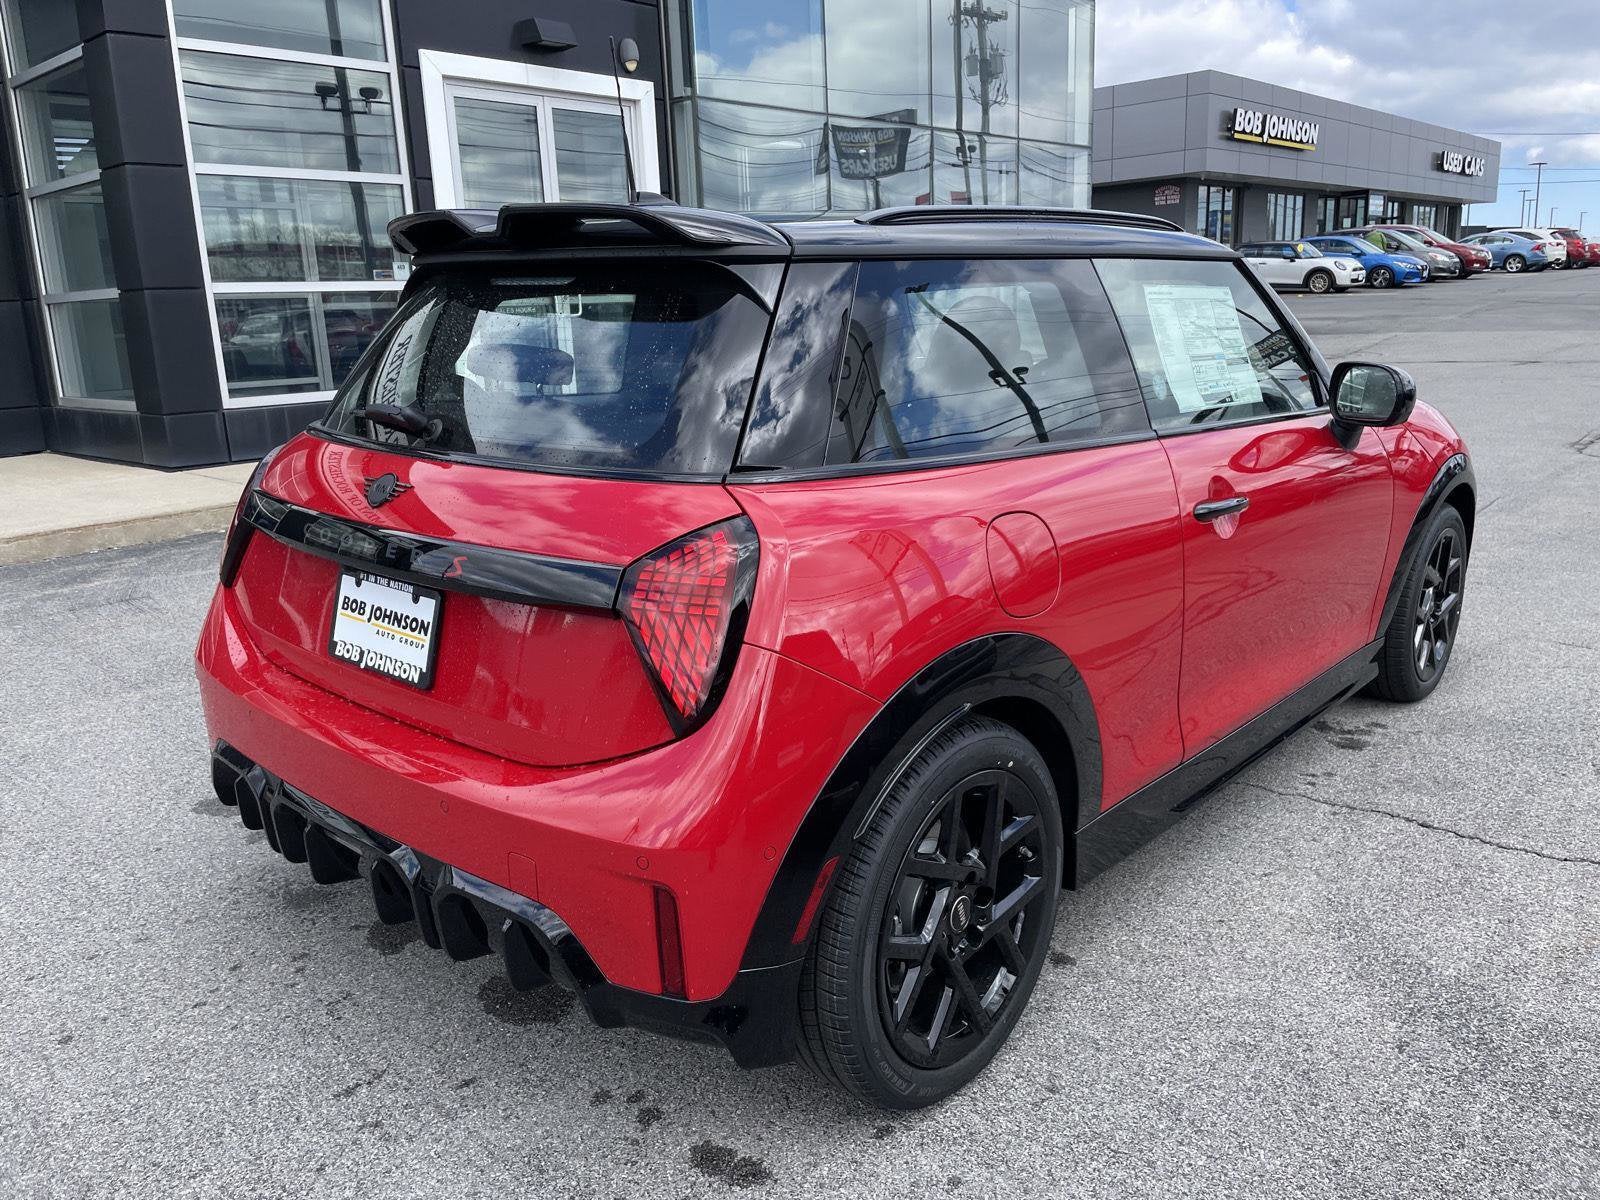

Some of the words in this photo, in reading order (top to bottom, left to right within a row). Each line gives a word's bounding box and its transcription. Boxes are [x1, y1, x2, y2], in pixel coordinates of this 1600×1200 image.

[1234, 107, 1263, 135] BOB
[1263, 113, 1320, 145] JOHNSON
[1443, 150, 1463, 173] USED
[1464, 155, 1485, 177] CARS
[368, 574, 376, 583] IN
[376, 576, 389, 587] THE
[389, 579, 414, 593] NATION
[341, 595, 367, 616] BOB
[367, 604, 431, 636] JOHNSON
[375, 629, 395, 641] AUTO
[399, 636, 425, 651] GROUP
[334, 640, 362, 662] BOB
[360, 649, 421, 684] JOHNSON
